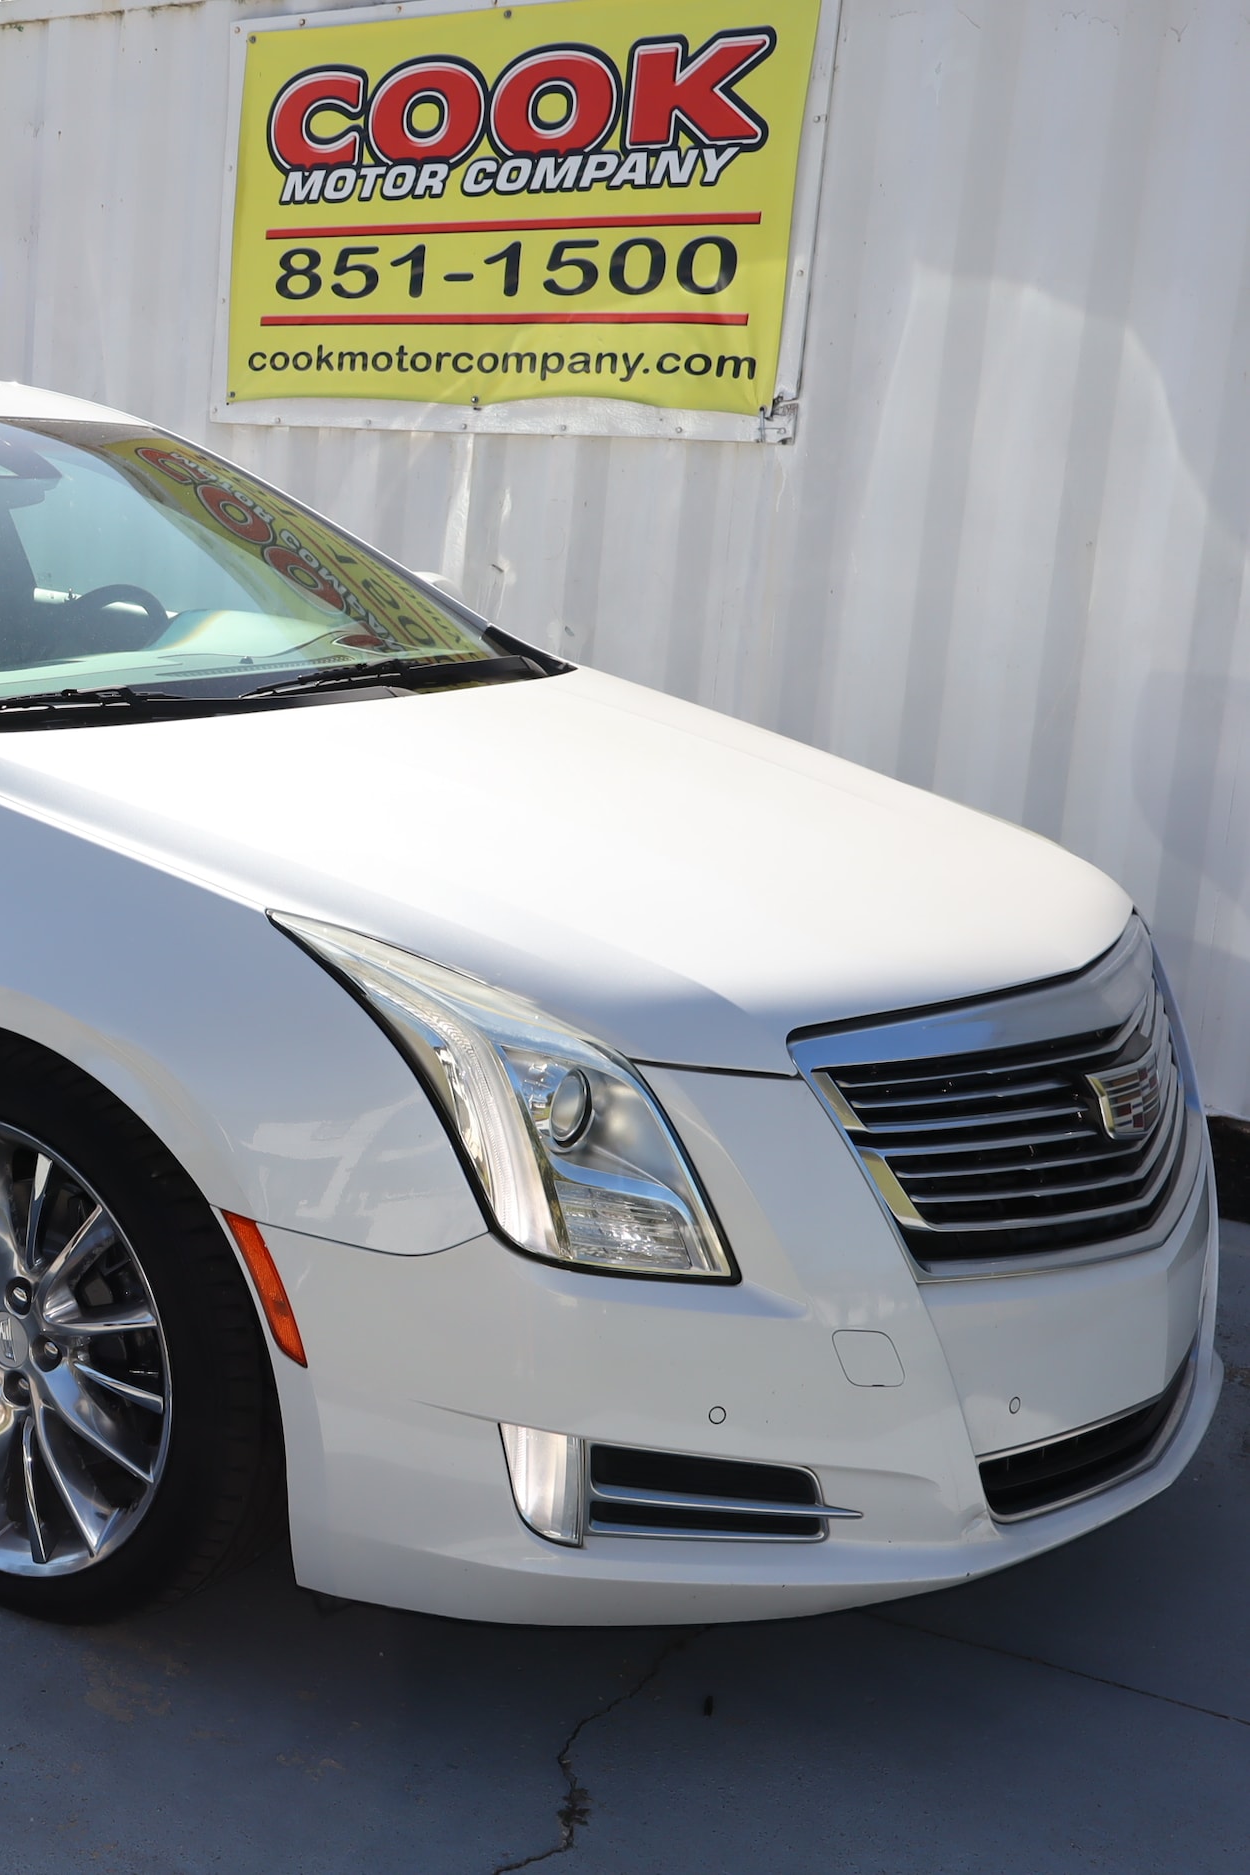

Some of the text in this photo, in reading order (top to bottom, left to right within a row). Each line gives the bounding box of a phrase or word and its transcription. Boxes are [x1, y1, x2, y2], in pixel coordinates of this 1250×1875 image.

[267, 25, 777, 171] COOK
[280, 147, 741, 204] MOTOR COMPANY
[275, 235, 738, 299] 851-1500
[248, 344, 757, 381] cookmotorcompany.com
